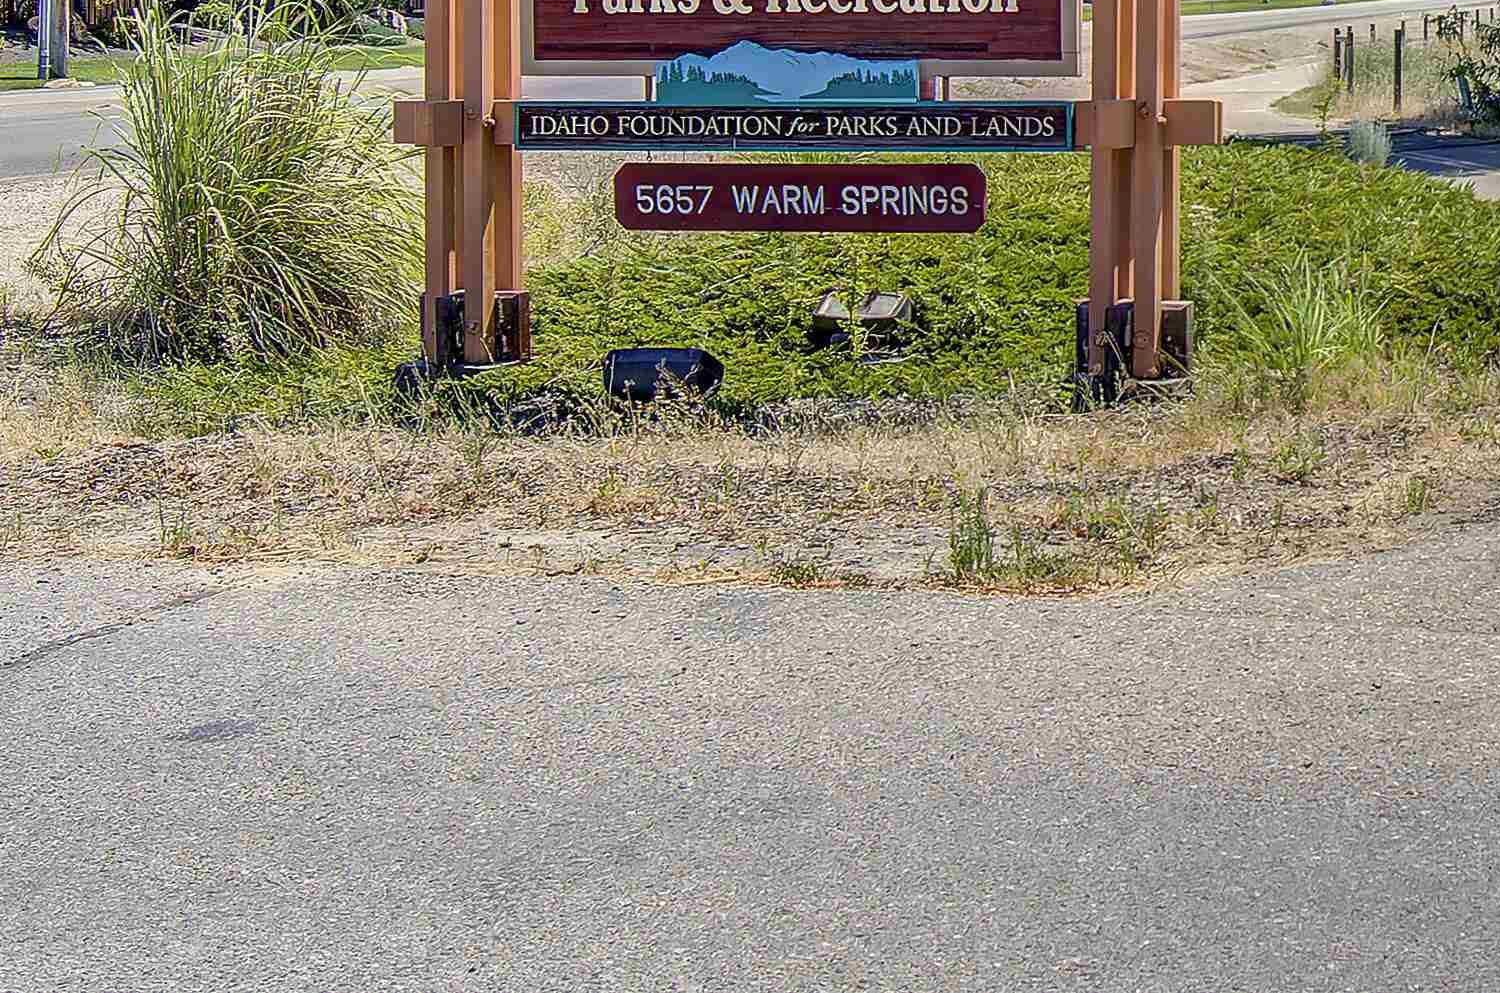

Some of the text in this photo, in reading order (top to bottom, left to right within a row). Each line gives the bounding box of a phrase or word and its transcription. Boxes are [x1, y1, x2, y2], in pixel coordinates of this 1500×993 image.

[531, 115, 1055, 137] IDAHO FOUNDATION for PARKS AND LANDS
[635, 184, 969, 216] 5657 WARM SPRINGS
